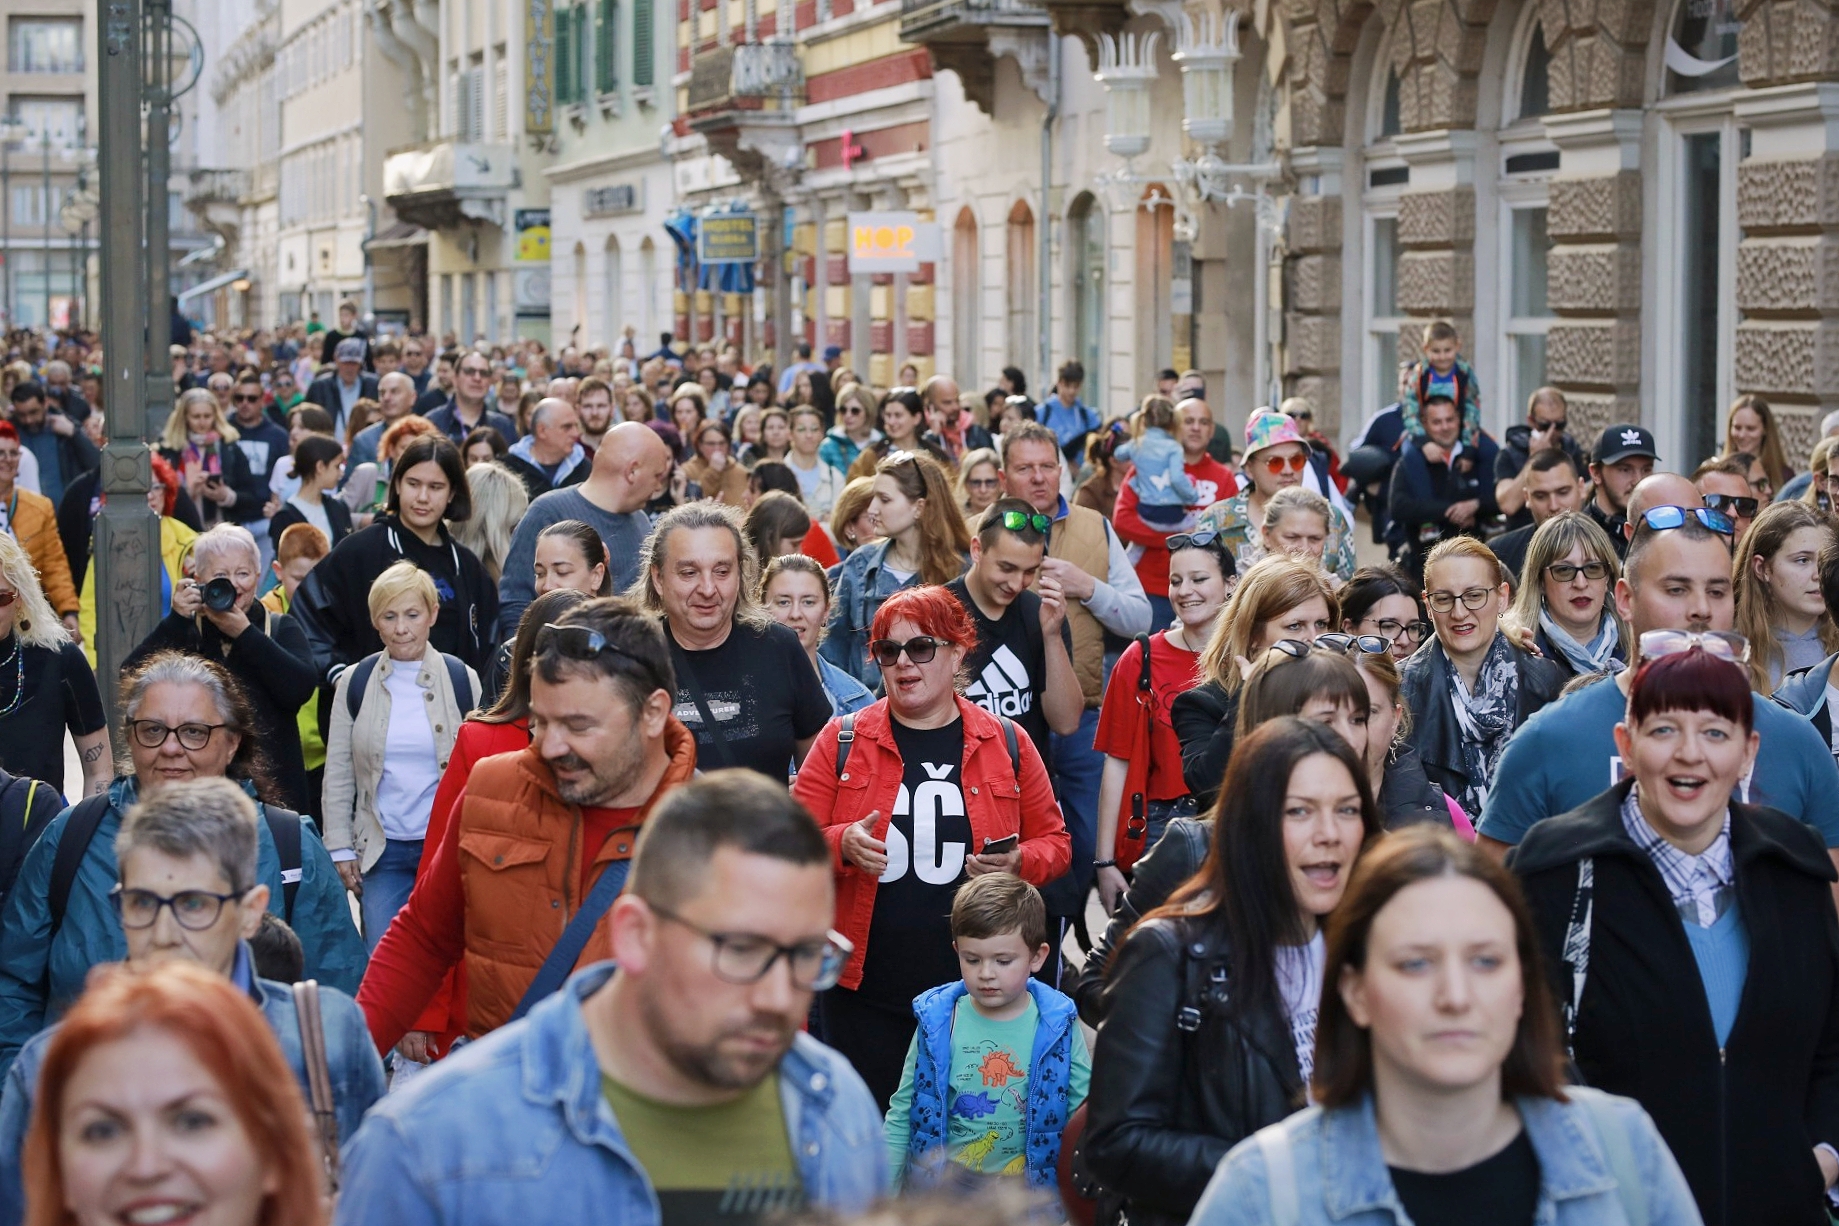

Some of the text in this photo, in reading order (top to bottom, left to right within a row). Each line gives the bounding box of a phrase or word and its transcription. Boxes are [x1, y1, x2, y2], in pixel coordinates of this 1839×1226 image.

[855, 226, 914, 251] HOP
[676, 706, 736, 717] ADVEURER
[970, 688, 1033, 717] dida
